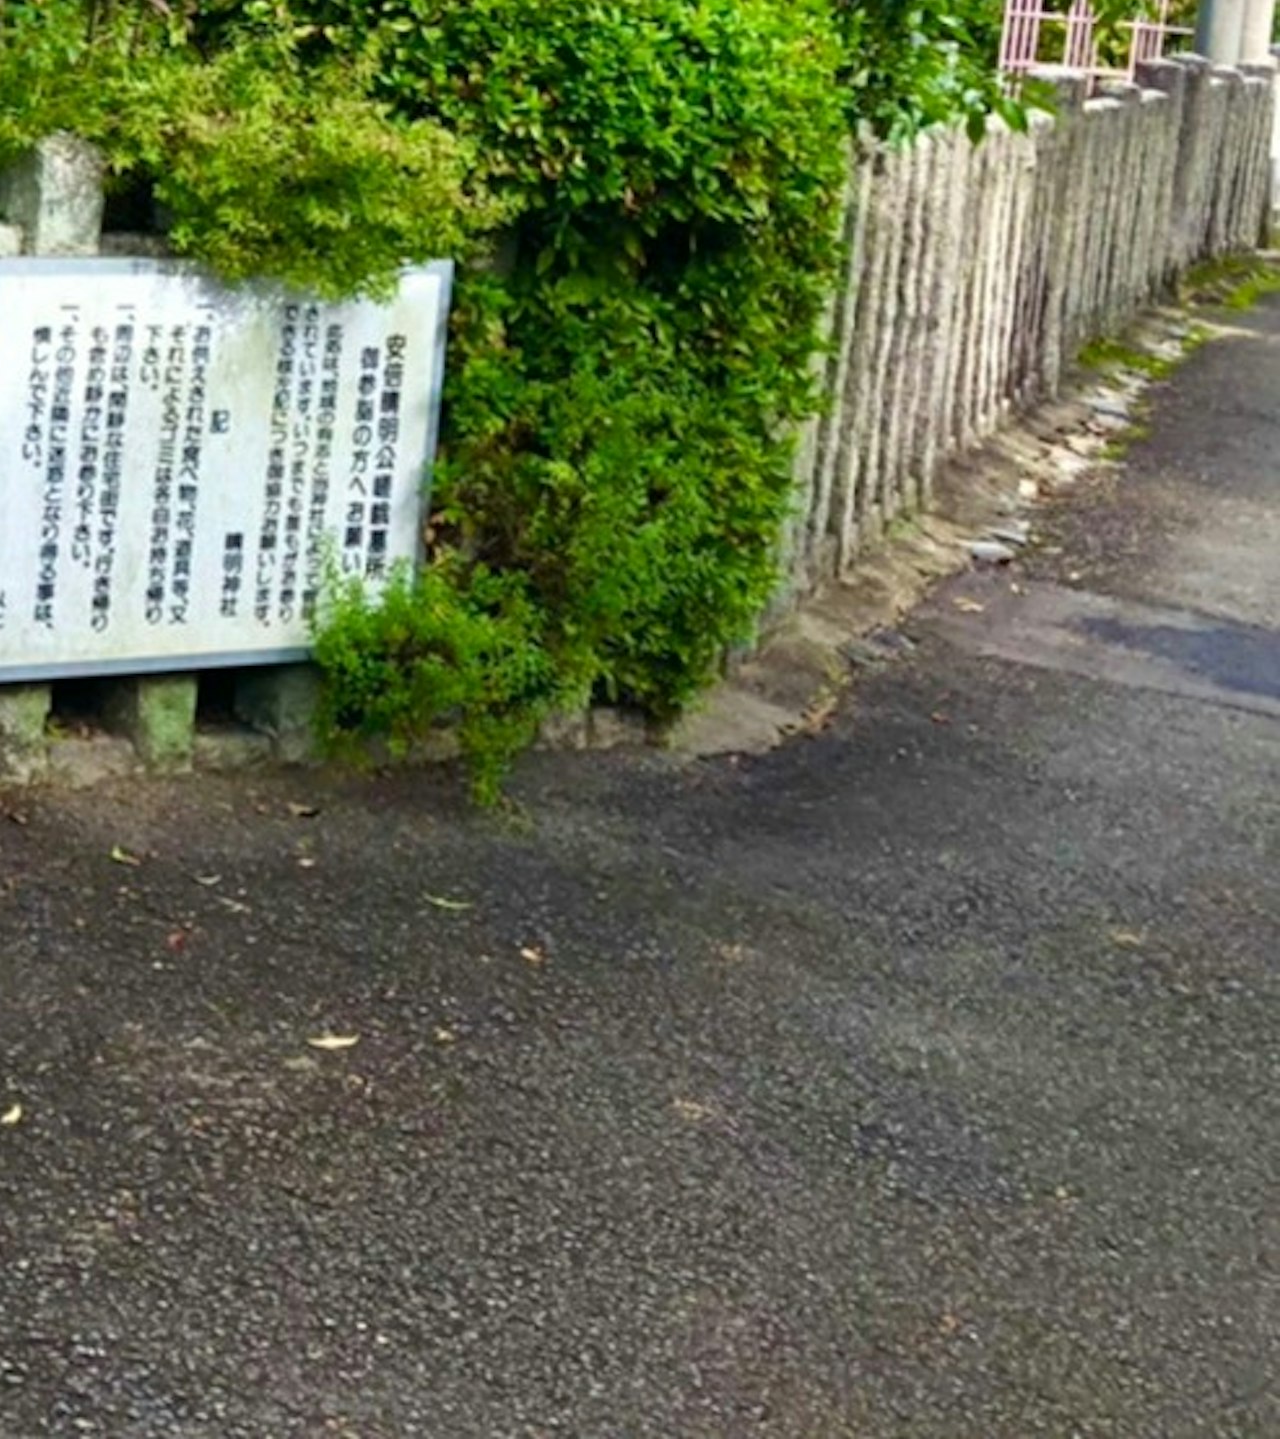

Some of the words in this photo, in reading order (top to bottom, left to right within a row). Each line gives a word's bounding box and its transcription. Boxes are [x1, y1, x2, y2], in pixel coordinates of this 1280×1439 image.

[140, 325, 162, 390] 下さい。
[210, 410, 230, 434] 記
[219, 532, 244, 617] 晴明神社
